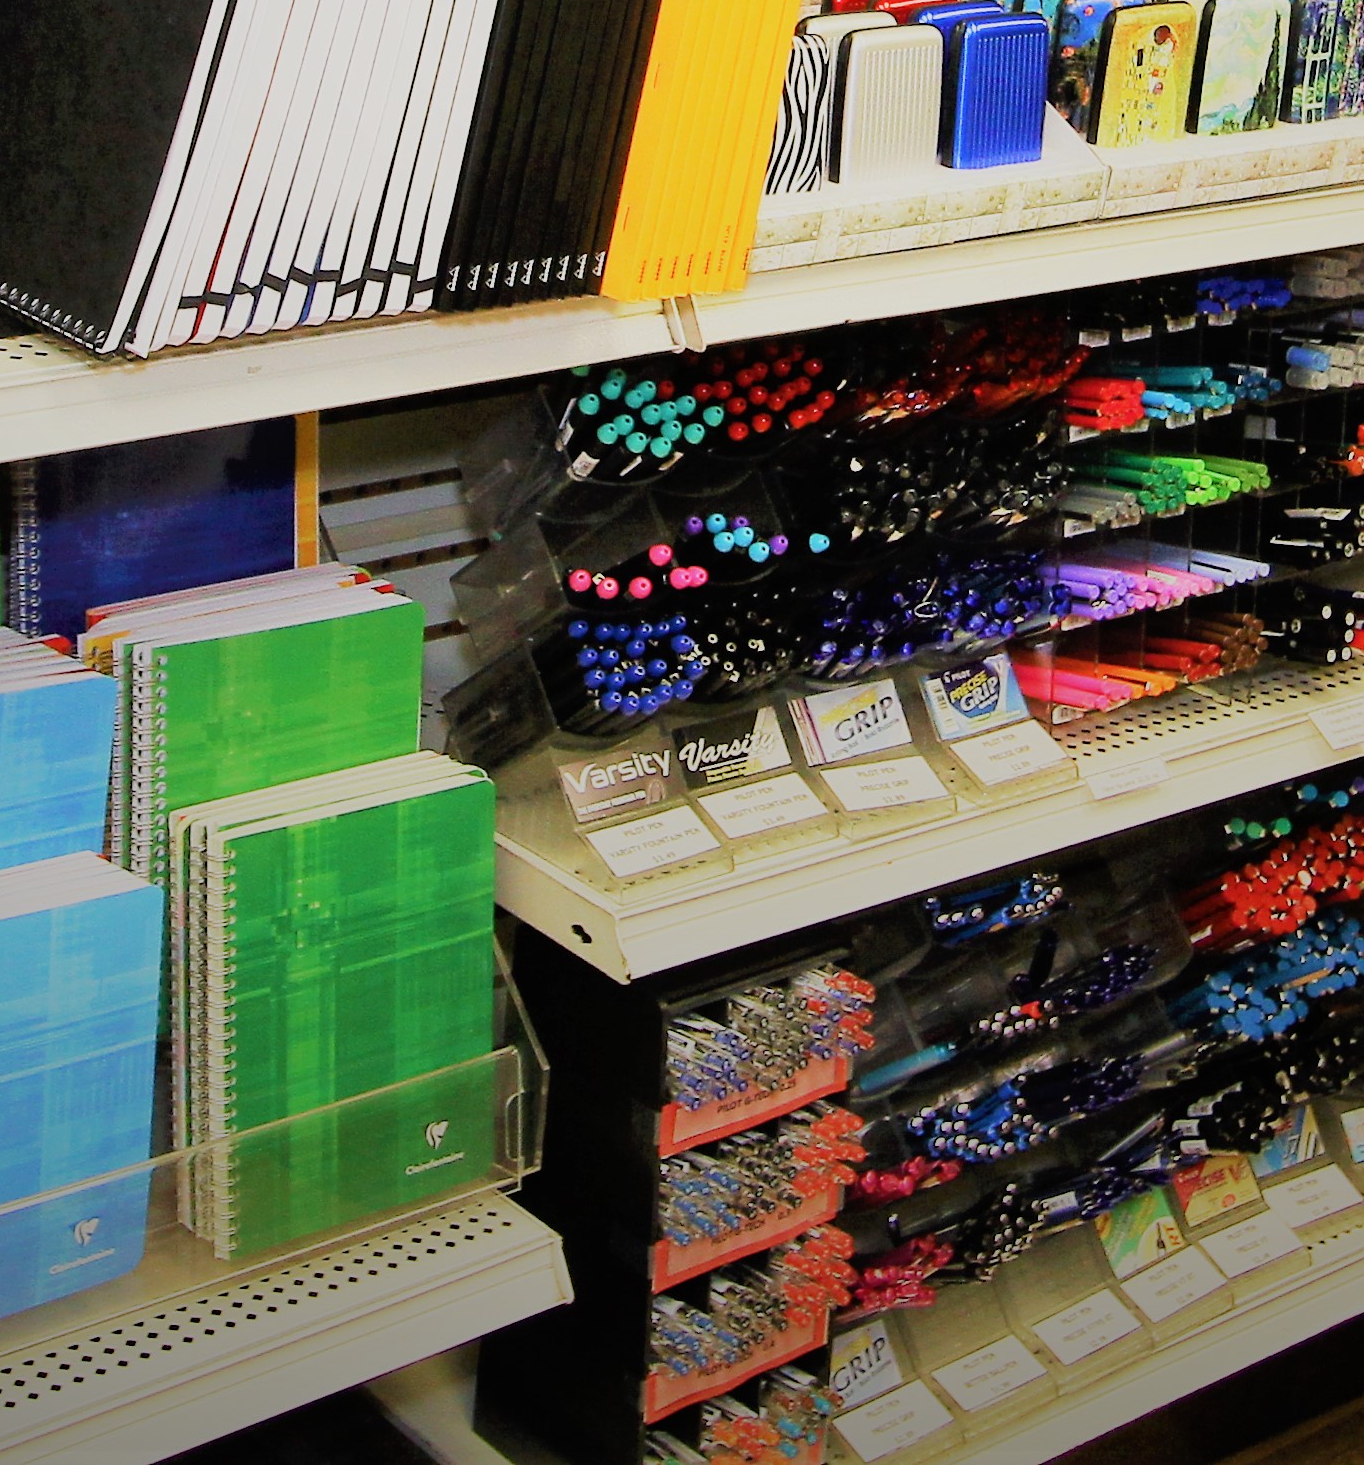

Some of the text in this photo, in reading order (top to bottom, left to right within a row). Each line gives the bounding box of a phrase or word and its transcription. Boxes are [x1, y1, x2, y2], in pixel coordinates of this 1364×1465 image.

[949, 672, 988, 703] PRECISE
[951, 669, 972, 682] PILOT
[960, 676, 999, 712] GRIP
[834, 695, 894, 743] GRIP
[678, 726, 778, 772] Varsity
[982, 736, 1002, 748] PILOT
[565, 749, 671, 794] Varsity
[857, 766, 897, 779] PILOT PEN
[734, 786, 775, 802] PILOT PEN
[860, 782, 893, 793] PRECISE
[721, 793, 809, 822] VARSITY FOUNTAIN PEN
[647, 820, 664, 832] PEN
[609, 827, 702, 858] VARSITY FOUNTAIN PEN
[716, 1097, 743, 1115] PILOT
[831, 1335, 887, 1394] GRIP
